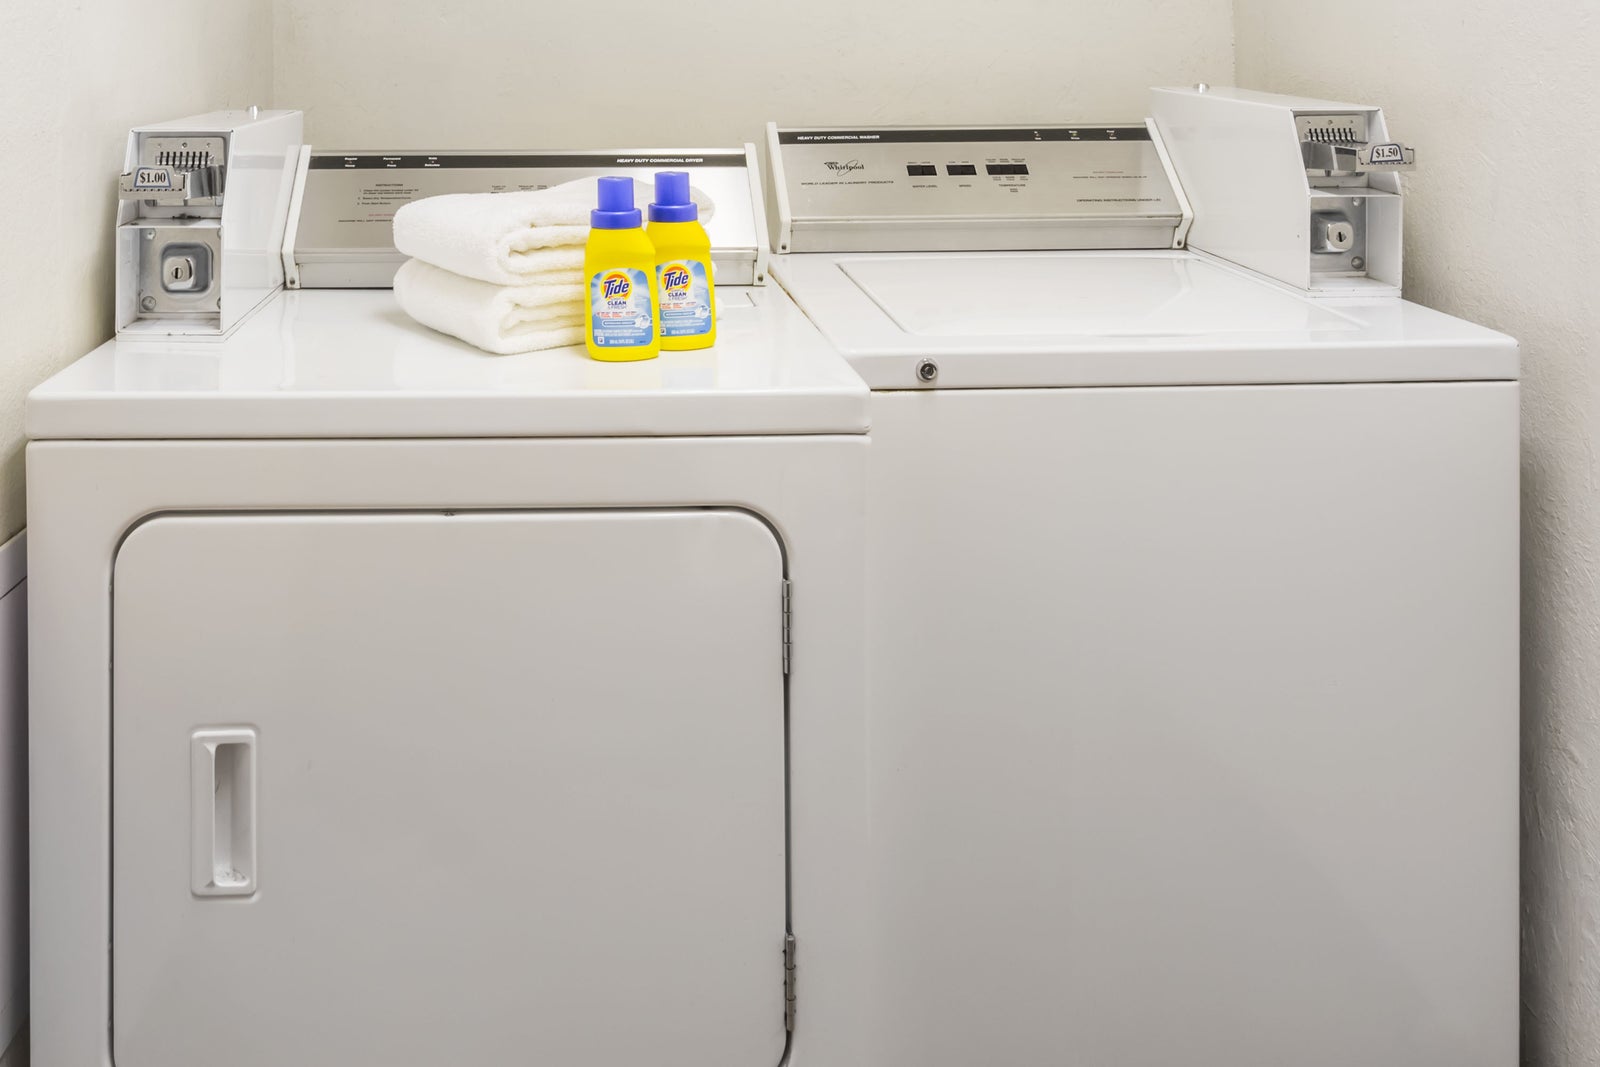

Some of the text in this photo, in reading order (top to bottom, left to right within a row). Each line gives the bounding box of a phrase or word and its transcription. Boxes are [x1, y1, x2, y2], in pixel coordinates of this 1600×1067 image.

[1375, 147, 1398, 158] $1.50
[826, 160, 864, 176] Whirlpool
[140, 172, 166, 184] $1.00
[604, 279, 630, 298] Tide
[664, 271, 688, 290] Tide
